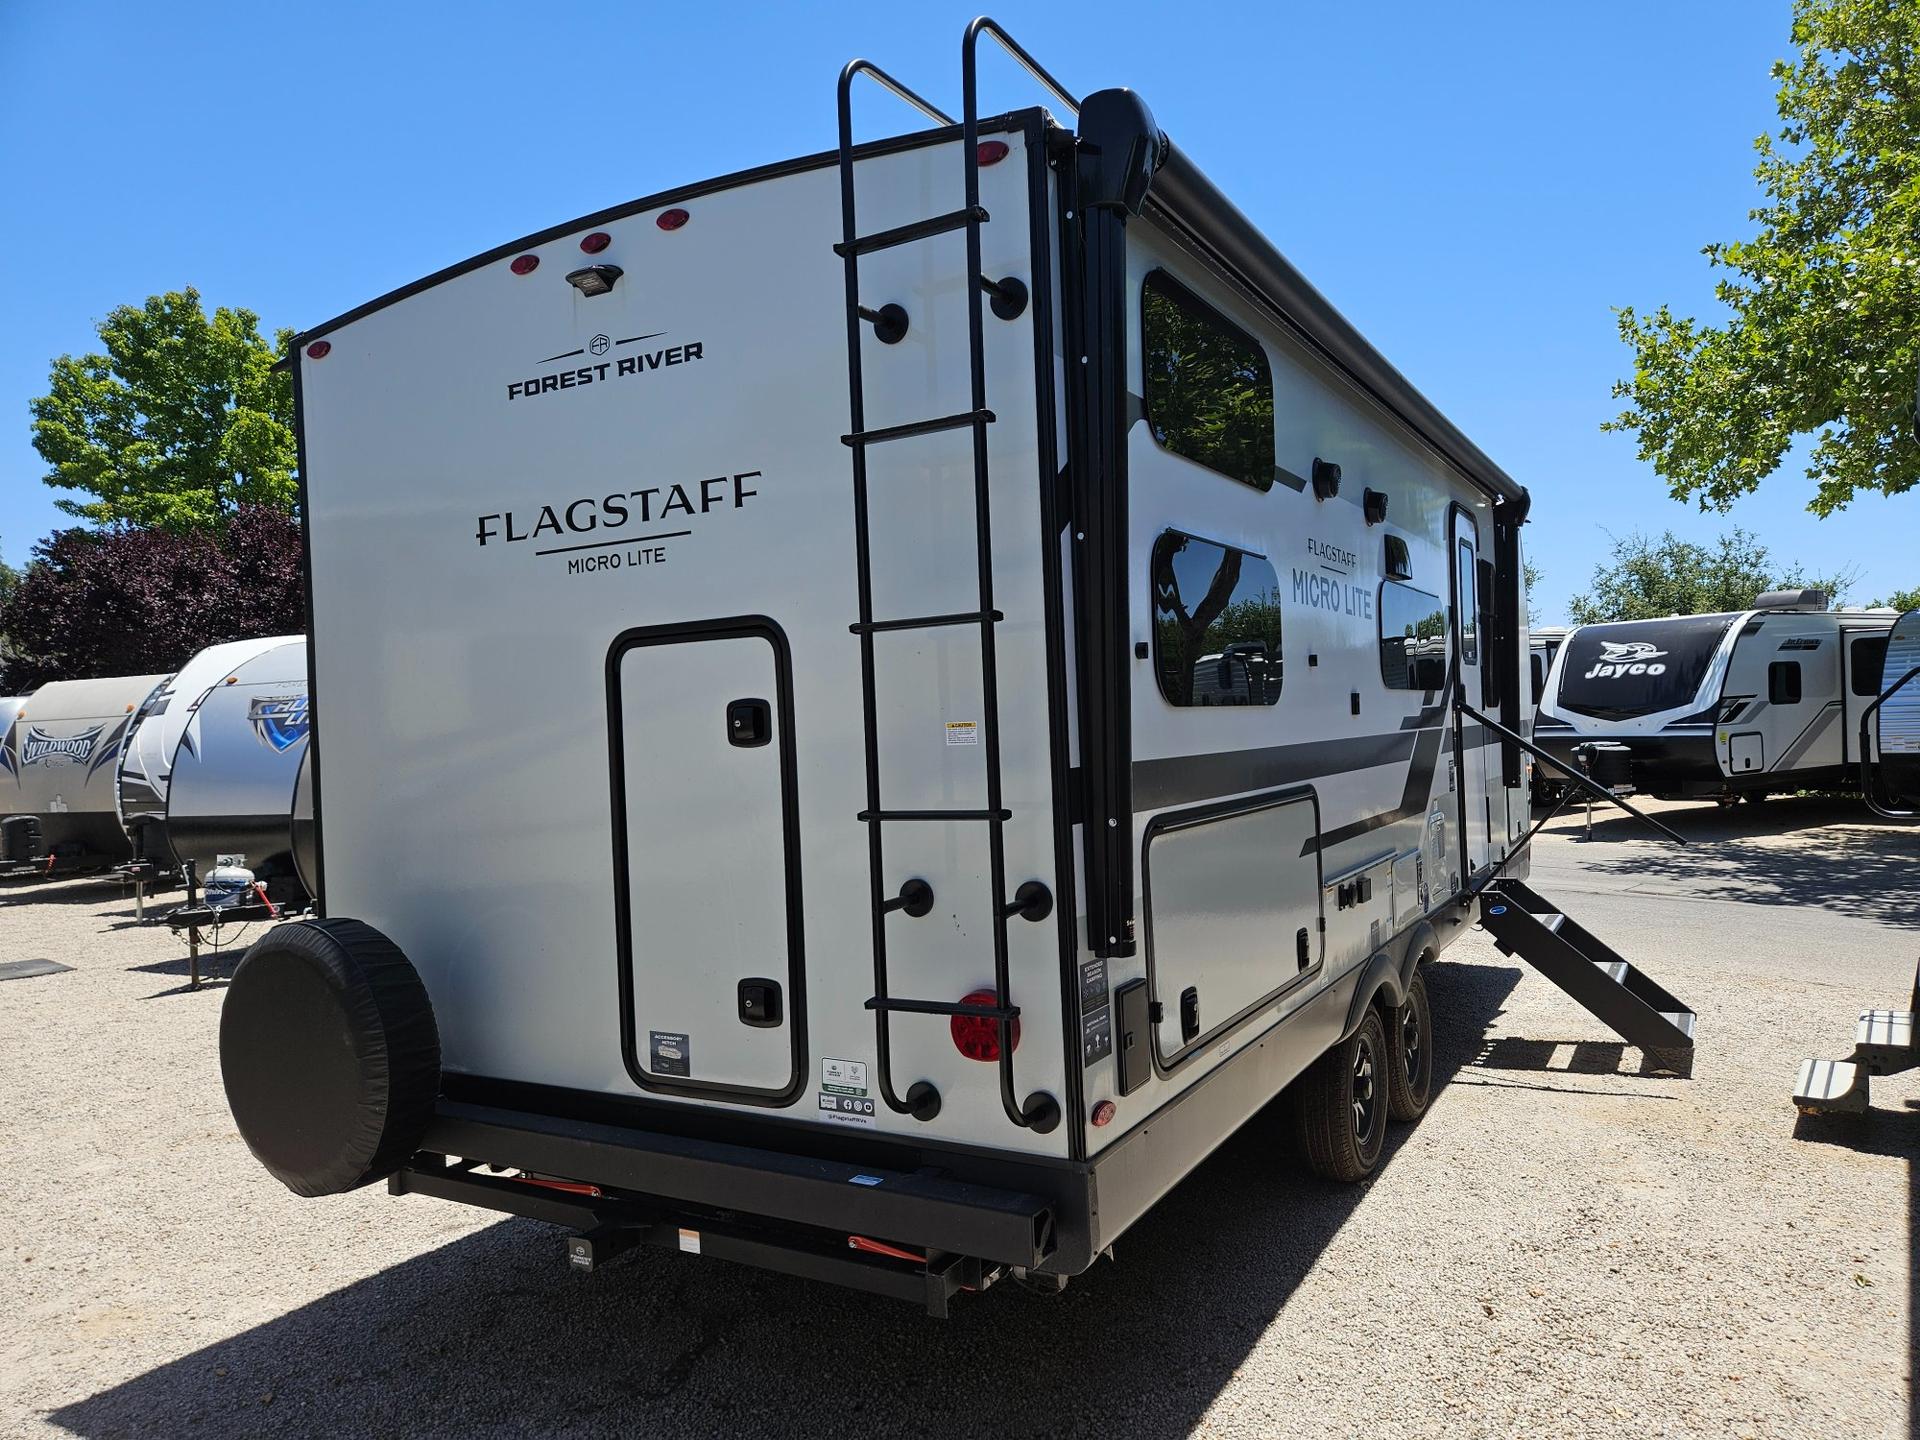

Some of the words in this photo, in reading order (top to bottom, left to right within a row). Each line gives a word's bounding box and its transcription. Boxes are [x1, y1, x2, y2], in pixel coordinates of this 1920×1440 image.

[507, 362, 611, 401] FOREST
[616, 341, 704, 377] RIVER
[475, 470, 762, 547] FLAGSTAFF
[567, 553, 621, 575] MICRO
[627, 547, 666, 567] LITE
[1307, 537, 1357, 568] FLAGSTAFF
[1292, 567, 1340, 613] MICRO
[1344, 583, 1373, 620] LITE
[1584, 662, 1666, 679] Jayco
[26, 739, 91, 759] WILDWOOD
